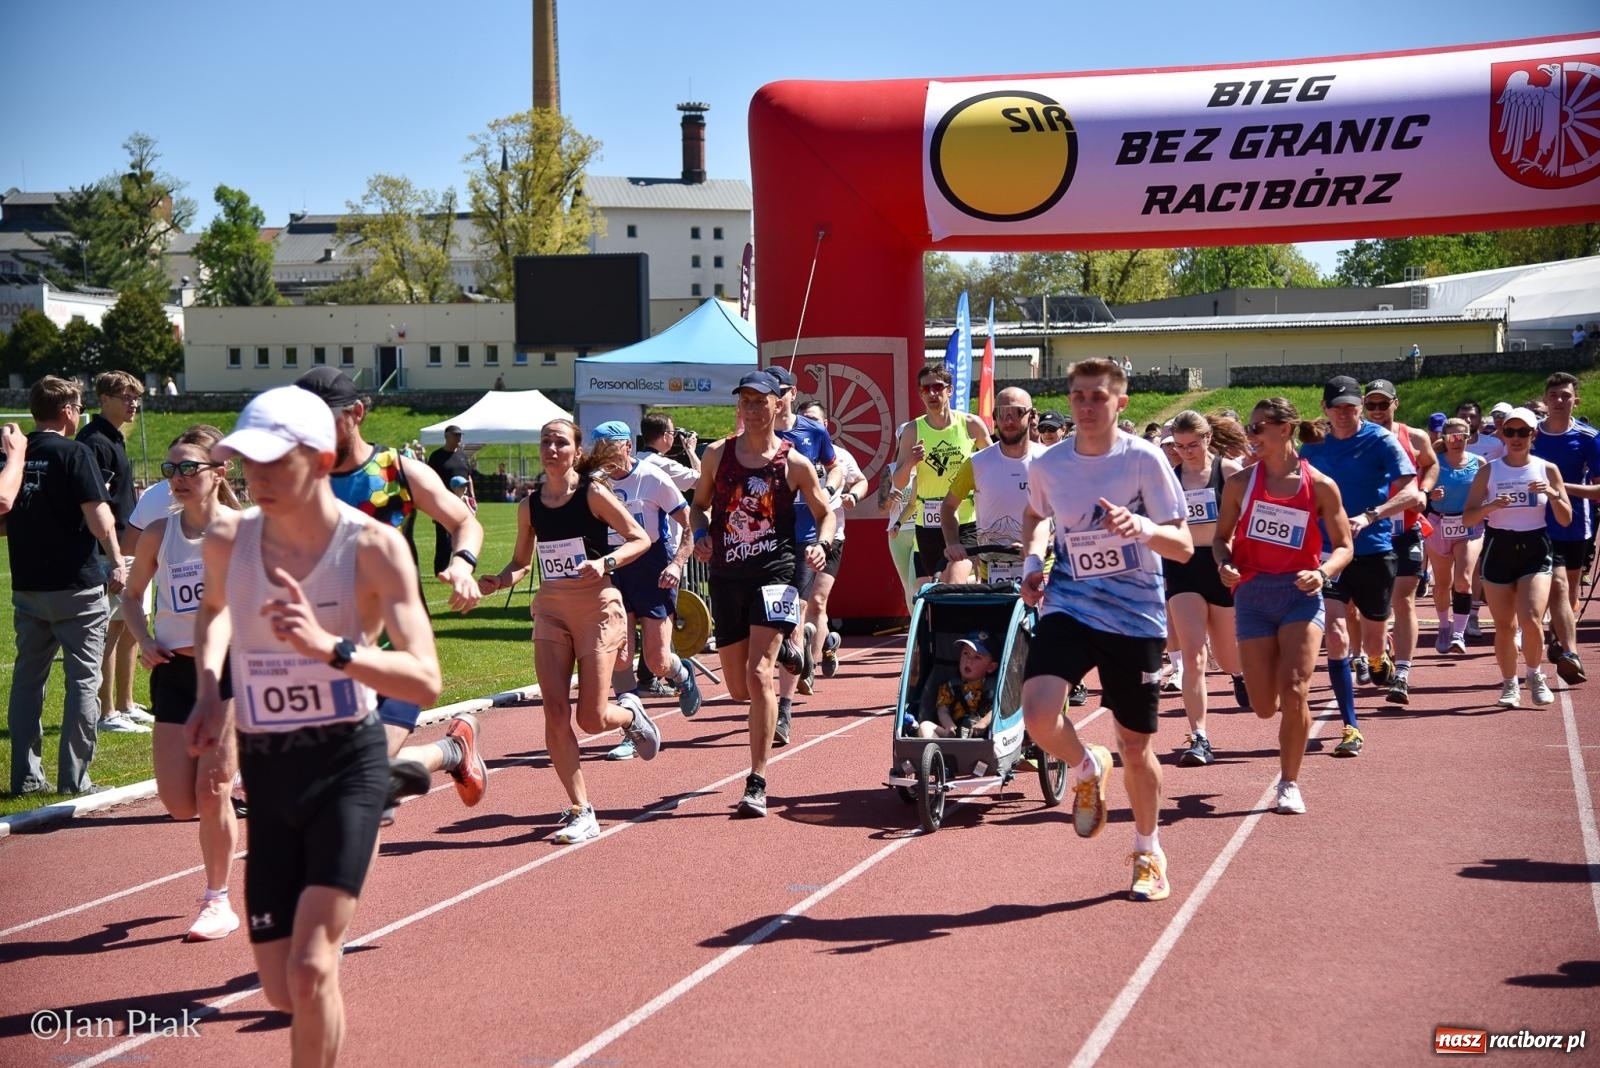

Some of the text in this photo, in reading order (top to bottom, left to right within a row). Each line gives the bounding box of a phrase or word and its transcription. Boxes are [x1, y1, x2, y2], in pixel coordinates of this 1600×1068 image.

[1206, 74, 1336, 108] BIEG
[1001, 105, 1075, 133] SIR
[1115, 114, 1431, 165] BEZ GRANIC
[1141, 168, 1403, 215] RACIBÓRZ
[589, 377, 665, 391] PersonalBest
[926, 513, 941, 523] 06
[1187, 504, 1205, 518] 38
[1255, 519, 1290, 538] 058
[1445, 525, 1466, 536] 070
[725, 539, 778, 563] EXTREME
[1079, 549, 1120, 571] 033
[545, 557, 575, 574] 054
[179, 582, 205, 604] 06
[263, 684, 322, 714] 051
